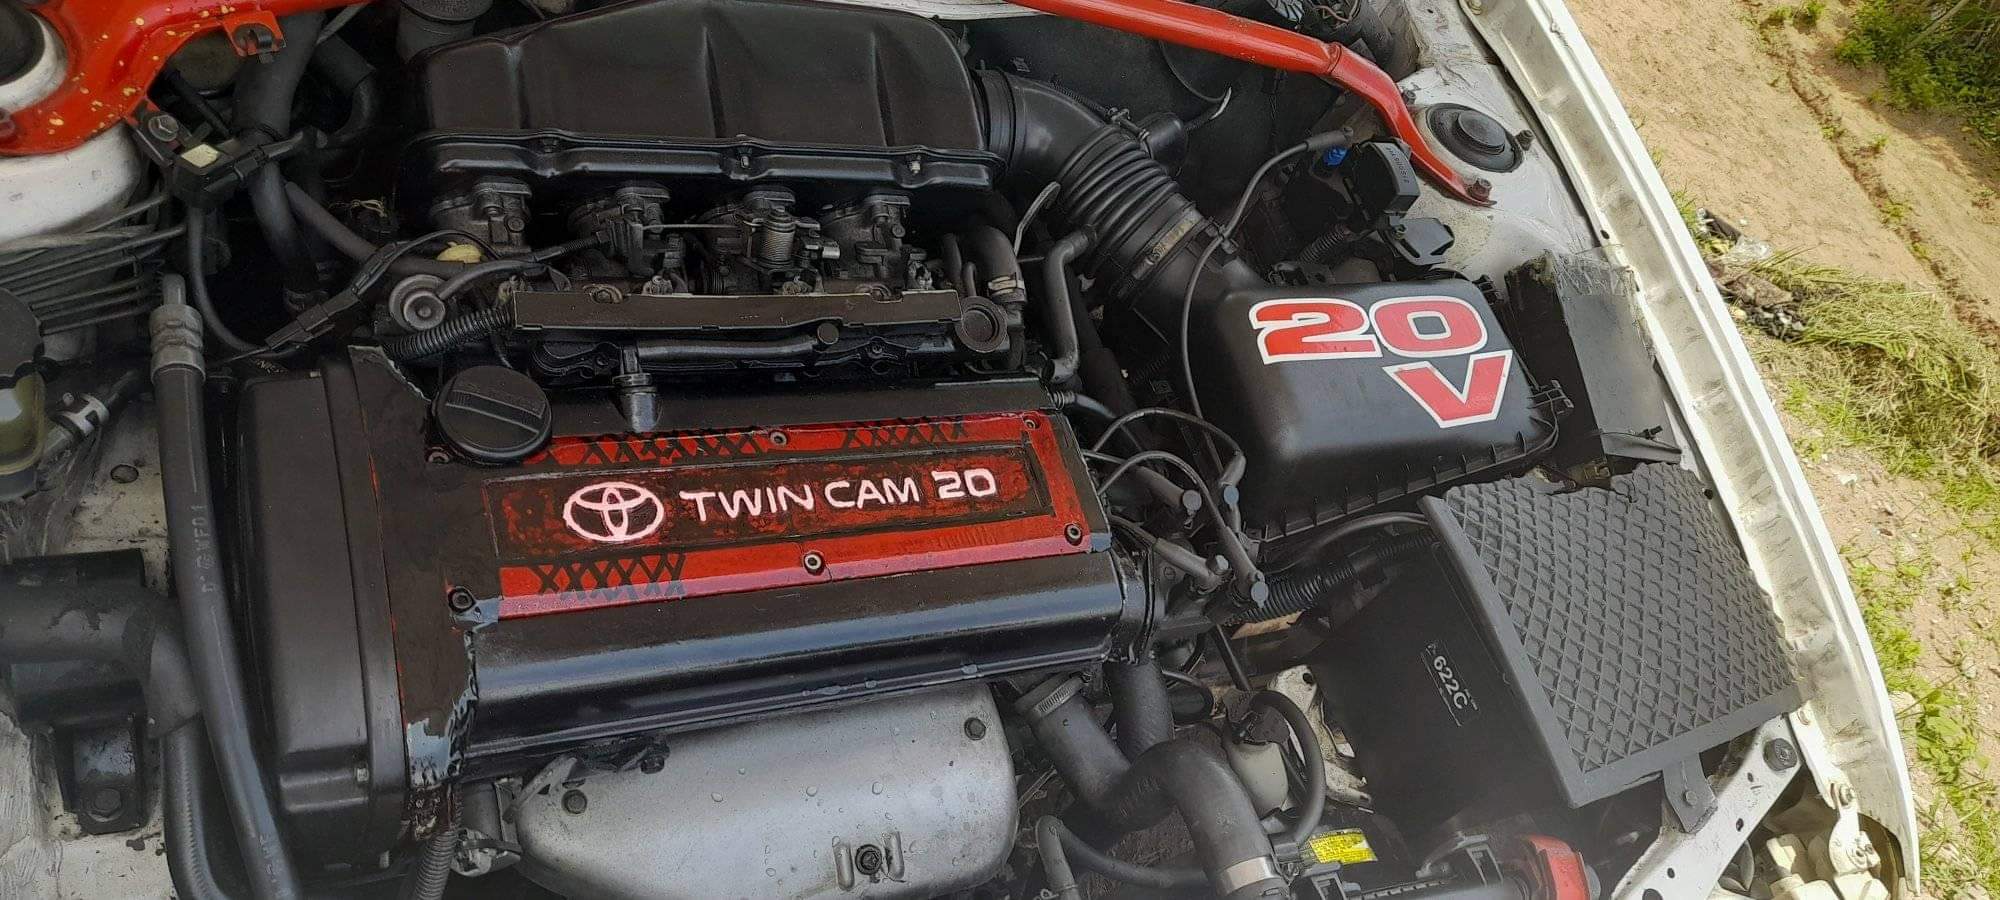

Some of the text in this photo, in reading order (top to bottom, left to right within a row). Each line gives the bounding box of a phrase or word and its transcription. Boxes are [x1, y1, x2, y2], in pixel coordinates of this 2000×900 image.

[1249, 295, 1488, 364] 20
[1382, 349, 1513, 429] V
[679, 467, 998, 522] TWIN CAM 20
[1433, 655, 1469, 710] 622C
